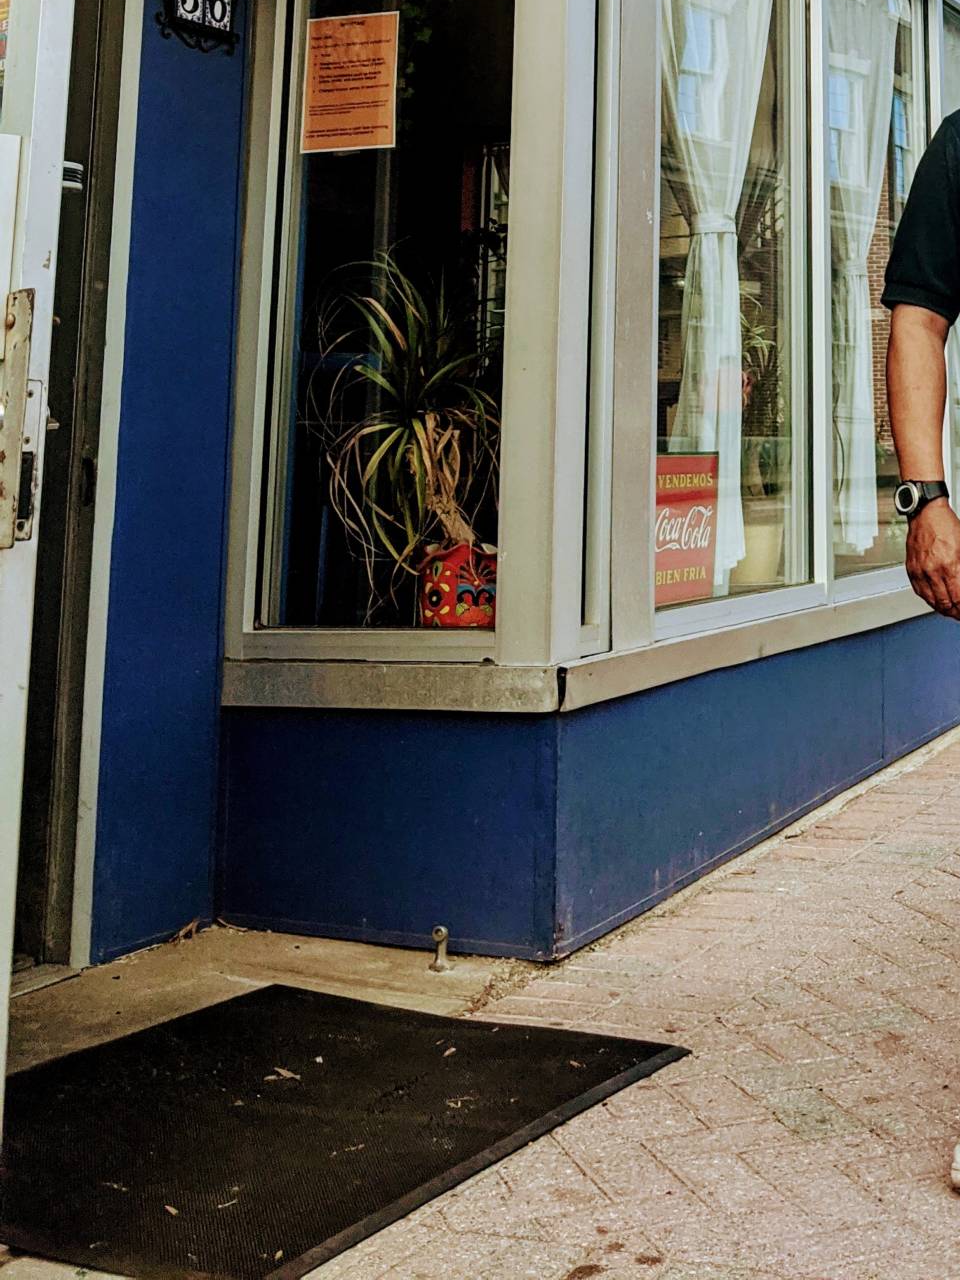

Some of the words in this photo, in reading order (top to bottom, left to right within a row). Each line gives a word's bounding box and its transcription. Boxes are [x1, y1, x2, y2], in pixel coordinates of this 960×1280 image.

[657, 473, 713, 489] VENDEMOS
[656, 570, 681, 586] BIEN
[684, 566, 707, 582] FRIA
